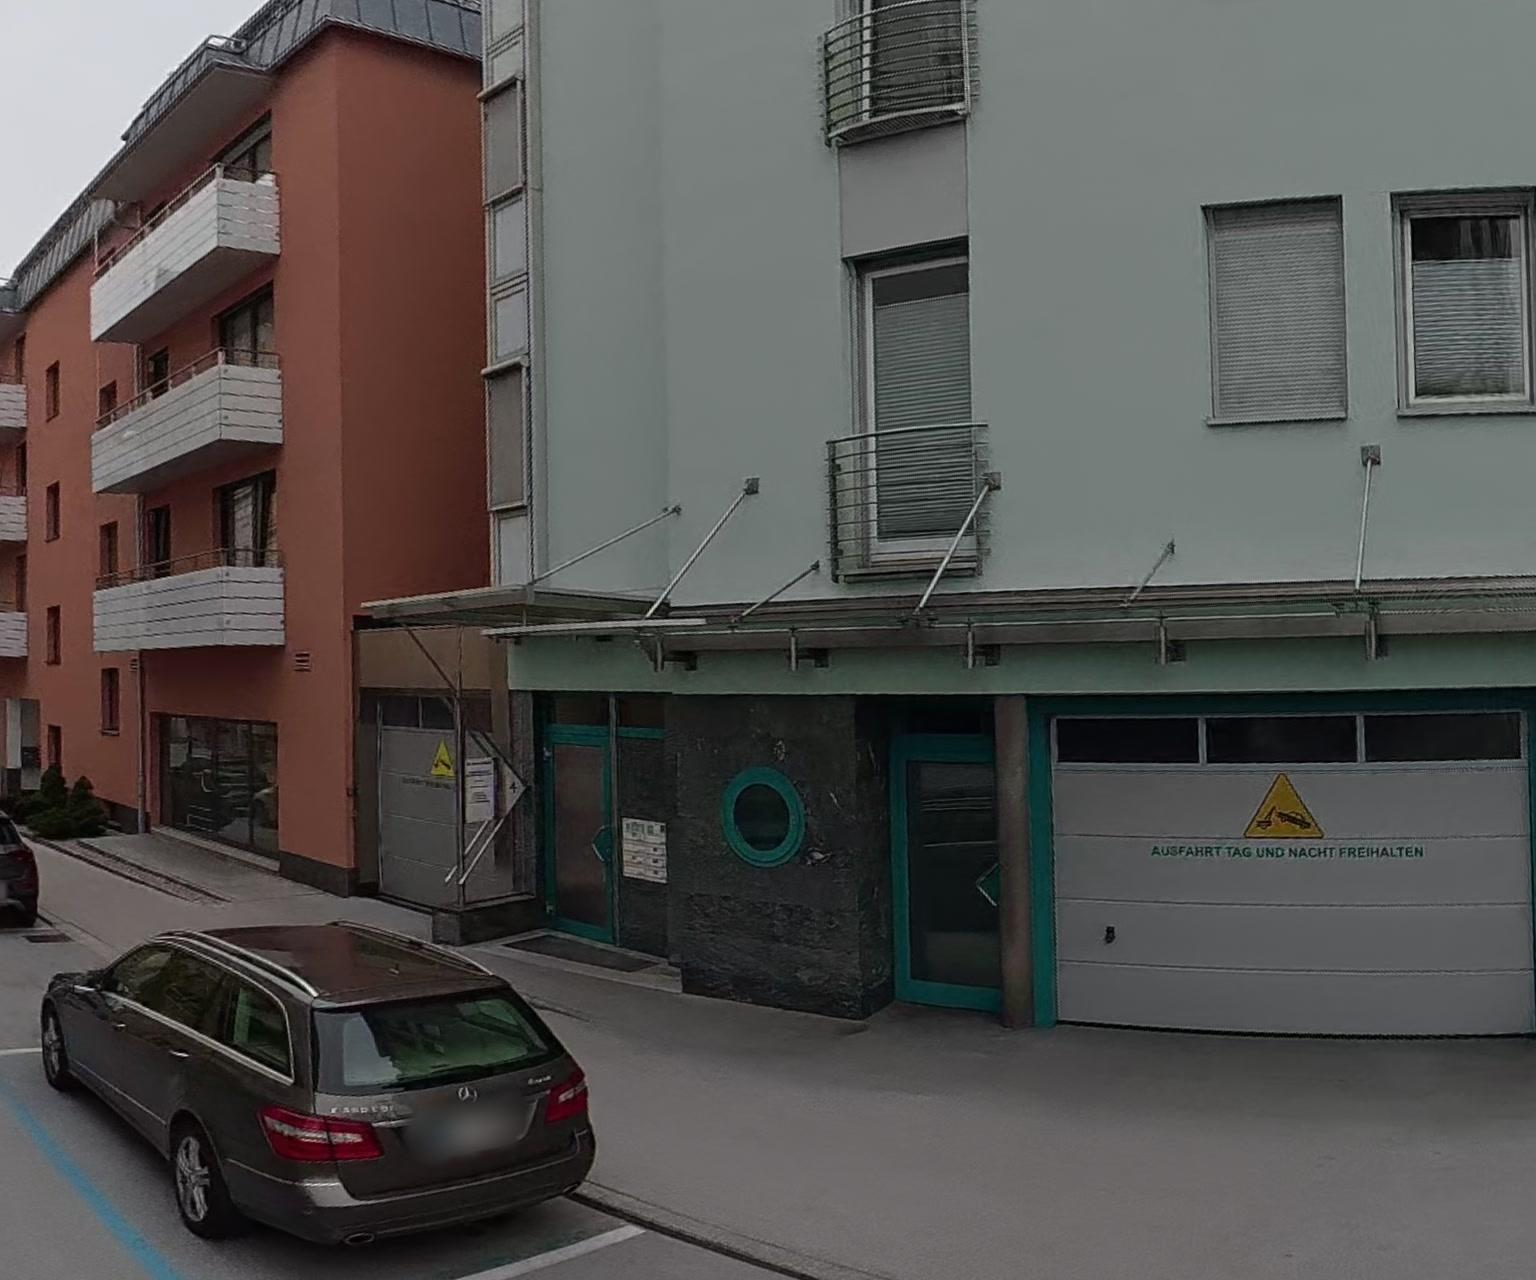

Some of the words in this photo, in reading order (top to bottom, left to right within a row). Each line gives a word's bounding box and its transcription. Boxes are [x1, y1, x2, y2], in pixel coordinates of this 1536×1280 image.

[1151, 845, 1222, 857] AUSFAHRT
[1226, 845, 1252, 857] TAG
[1256, 846, 1285, 858] UND
[1288, 846, 1335, 858] NACHT
[1340, 845, 1424, 858] FREIHALTEN
